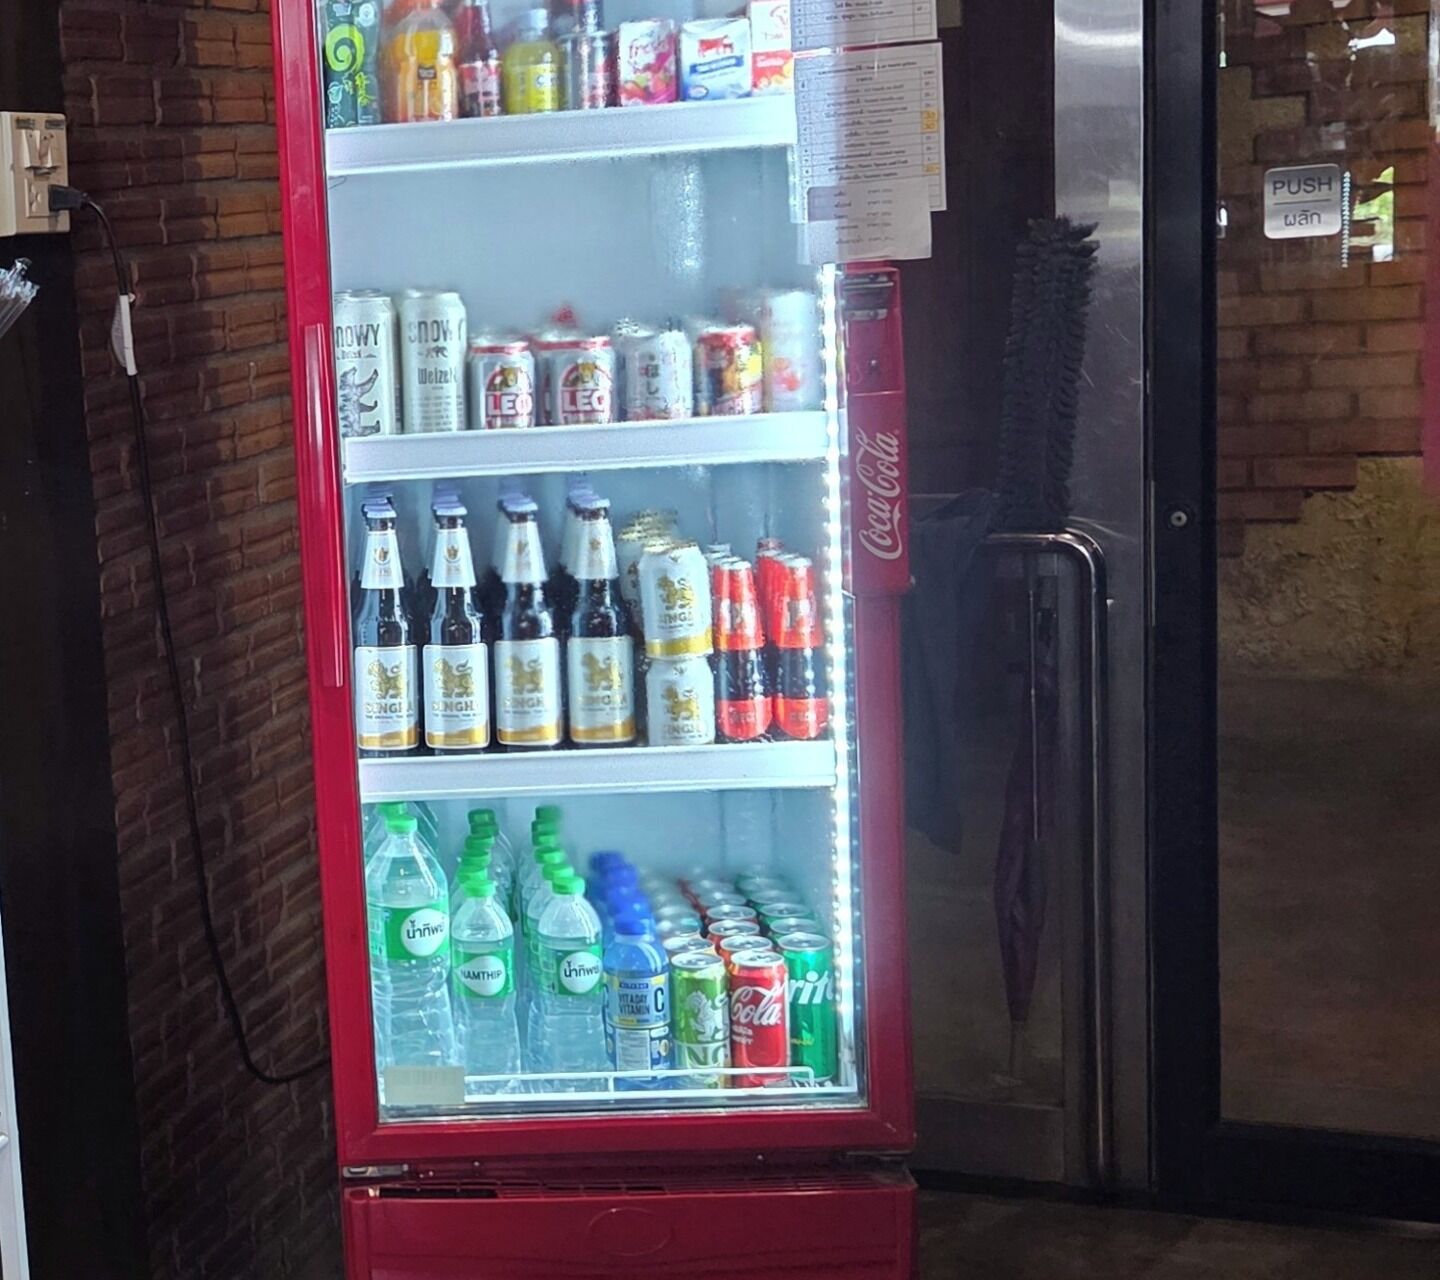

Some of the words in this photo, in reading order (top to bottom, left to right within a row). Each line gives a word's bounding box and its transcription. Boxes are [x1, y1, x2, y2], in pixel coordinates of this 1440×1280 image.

[1272, 176, 1333, 196] PUSH
[1283, 209, 1322, 227] ผลัก
[487, 393, 533, 416] LEO
[563, 389, 611, 412] LEO
[858, 427, 902, 561] Coca-Cola
[619, 1003, 650, 1016] VITAMIN
[654, 986, 665, 1013] C
[731, 982, 784, 1026] Cola
